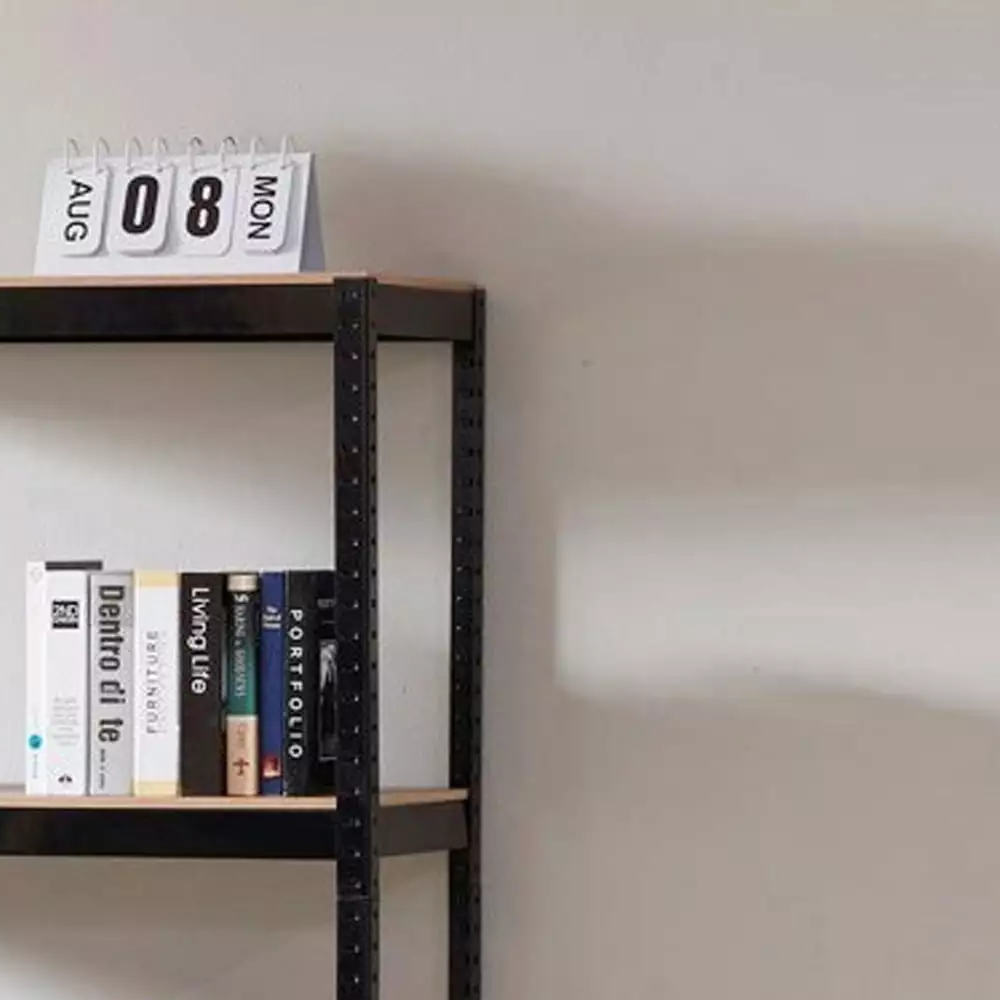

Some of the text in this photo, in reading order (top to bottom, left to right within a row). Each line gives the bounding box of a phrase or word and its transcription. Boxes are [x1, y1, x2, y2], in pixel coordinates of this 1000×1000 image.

[63, 180, 94, 242] AUG
[247, 175, 278, 240] MON
[98, 585, 126, 743] Dentro di te
[146, 630, 160, 735] FURNITURE
[187, 587, 211, 695] Living Life
[287, 608, 304, 760] PORTFOLIO
